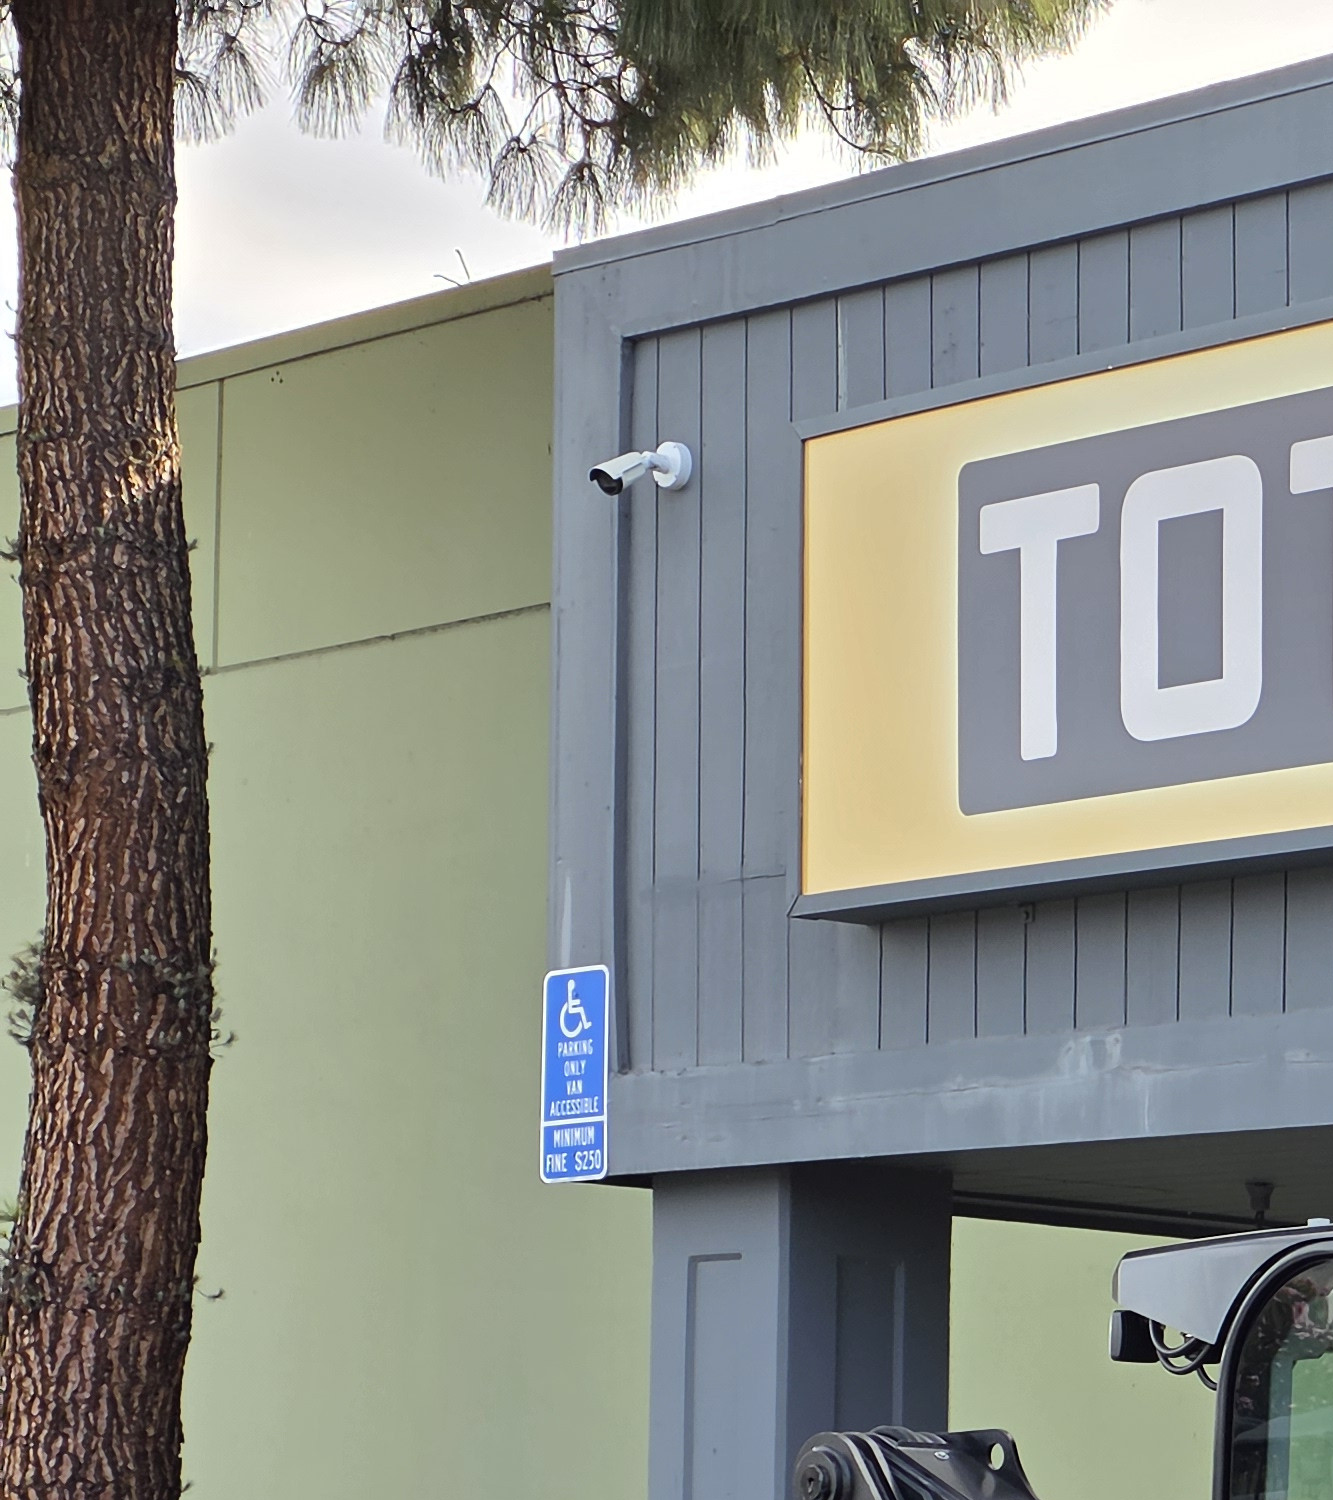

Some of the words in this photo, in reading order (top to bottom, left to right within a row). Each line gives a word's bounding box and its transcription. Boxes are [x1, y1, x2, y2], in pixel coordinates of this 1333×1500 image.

[557, 1038, 593, 1058] PARKING
[564, 1059, 586, 1077] ONLY
[566, 1079, 583, 1096] VAN
[550, 1096, 599, 1117] ACCESSIBLE
[553, 1126, 595, 1148] MINIMUM
[546, 1152, 568, 1173] FINE
[574, 1149, 602, 1172] $250
